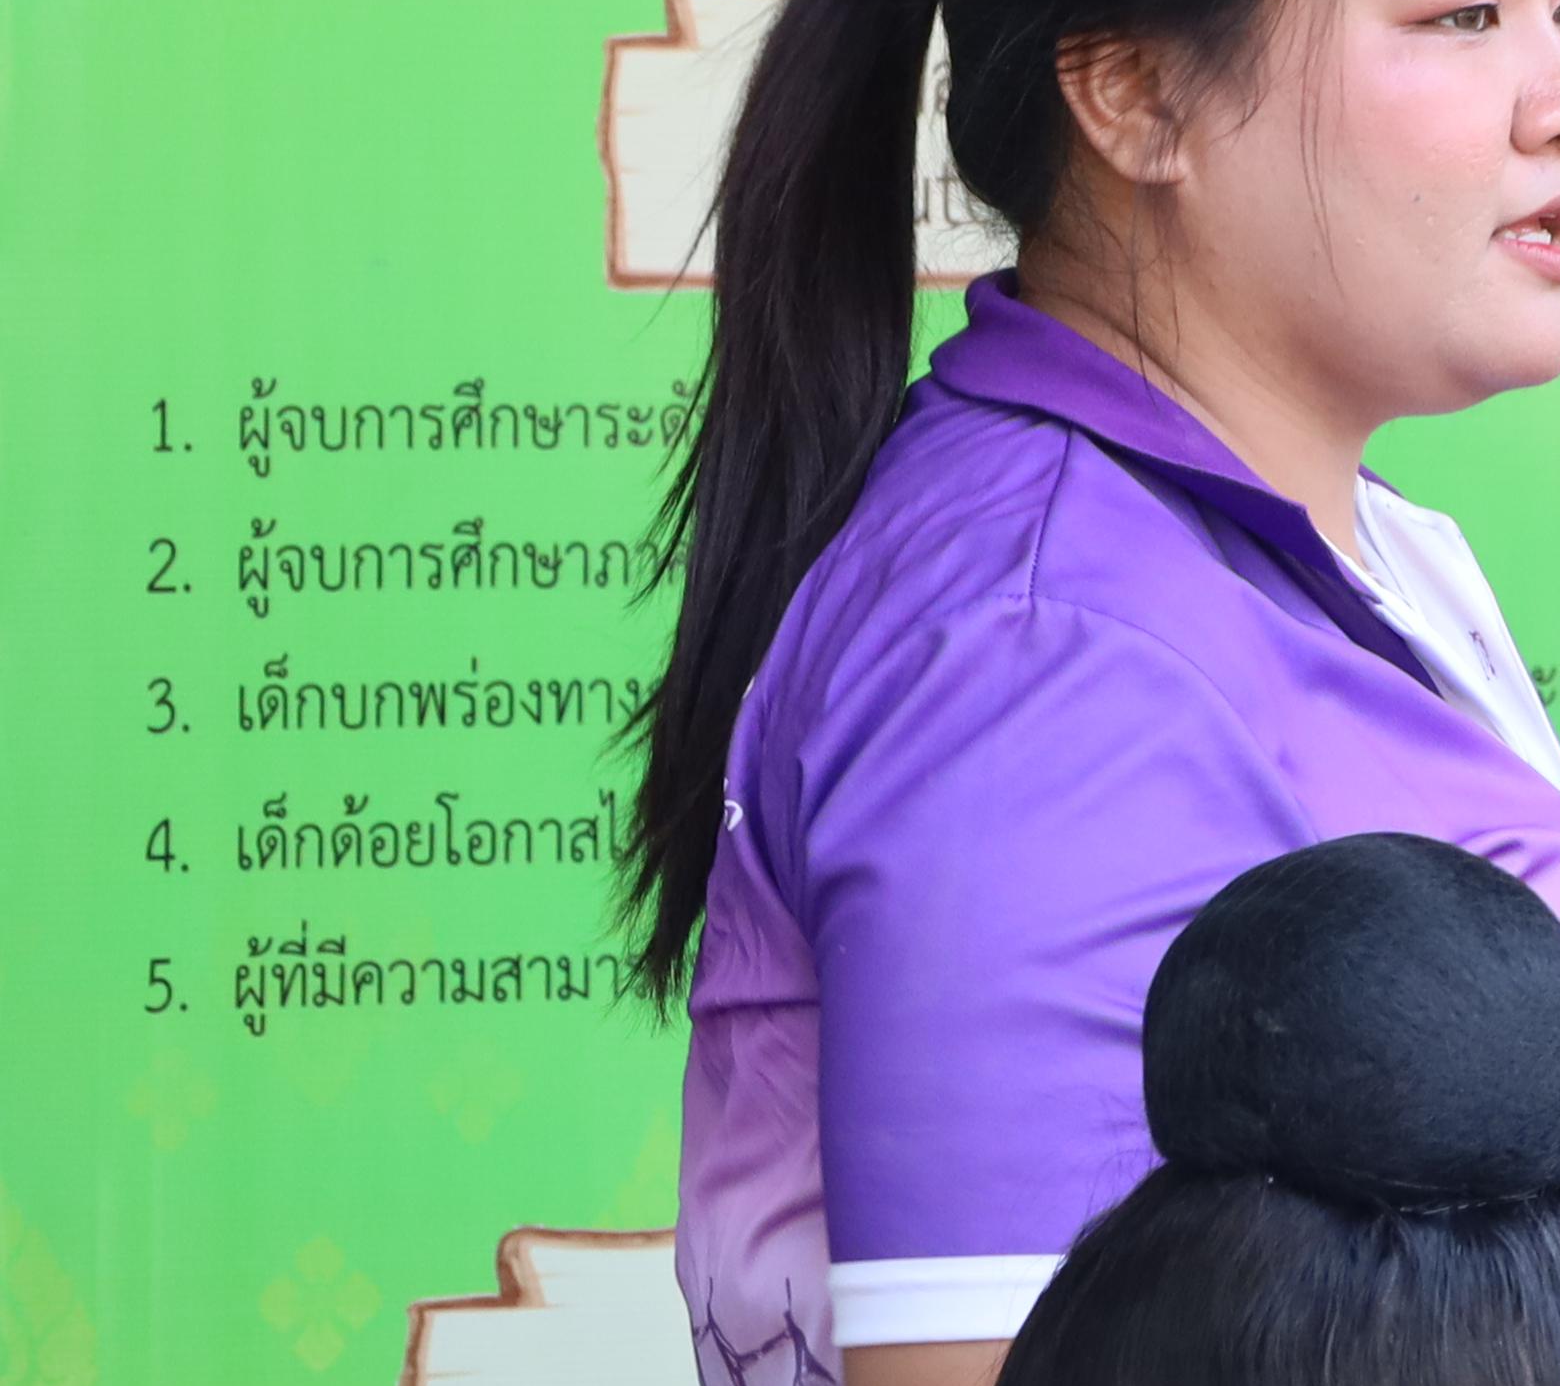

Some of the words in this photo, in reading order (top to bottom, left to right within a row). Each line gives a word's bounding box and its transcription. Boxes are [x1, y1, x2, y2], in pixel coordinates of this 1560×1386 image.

[153, 397, 194, 455] 1.
[146, 539, 194, 595] 2.
[146, 678, 191, 734] 3.
[236, 654, 655, 733] เด็กบกพร่องทาง
[146, 819, 191, 874] 4.
[236, 791, 626, 873] เด็กด้อยโอกาสไ
[145, 959, 189, 1015] 5.
